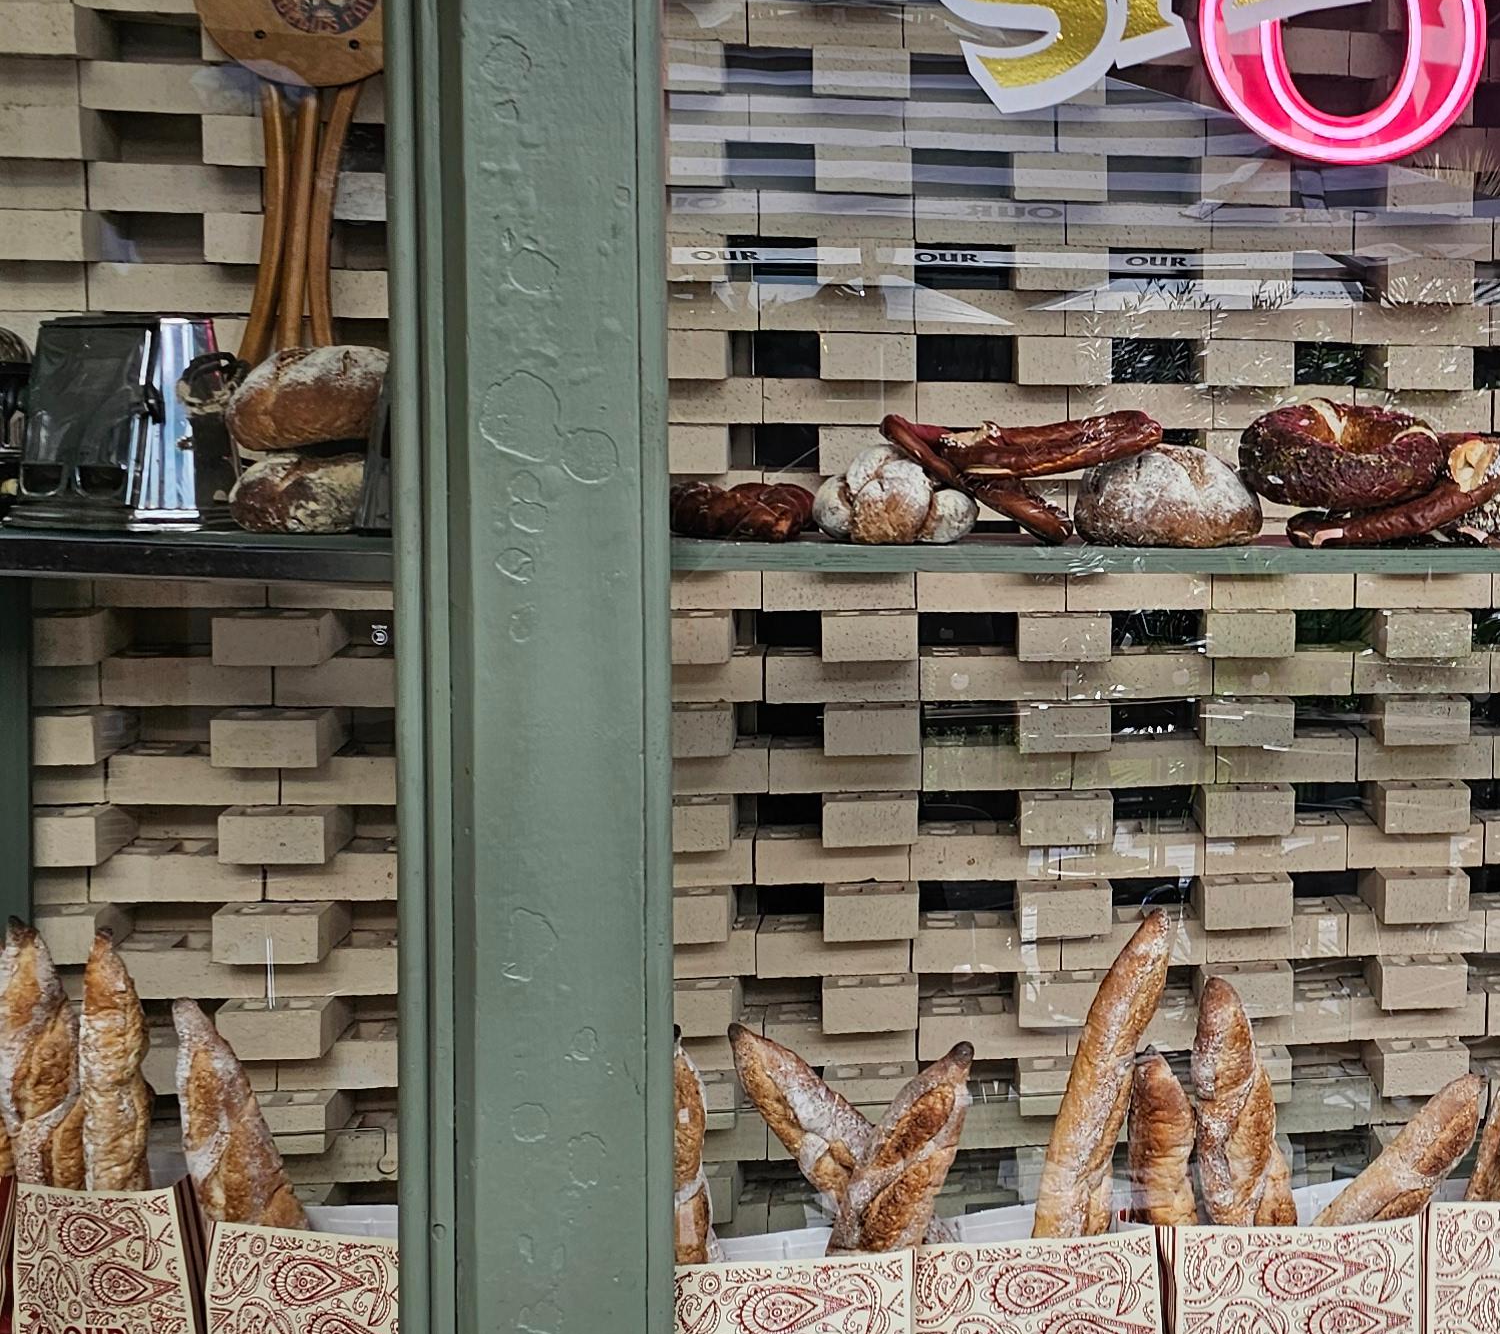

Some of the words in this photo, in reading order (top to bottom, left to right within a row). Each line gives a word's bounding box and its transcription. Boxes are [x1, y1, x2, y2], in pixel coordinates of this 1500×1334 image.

[690, 249, 758, 261] OUR
[914, 252, 980, 264] OUR
[1125, 255, 1188, 267] OUR
